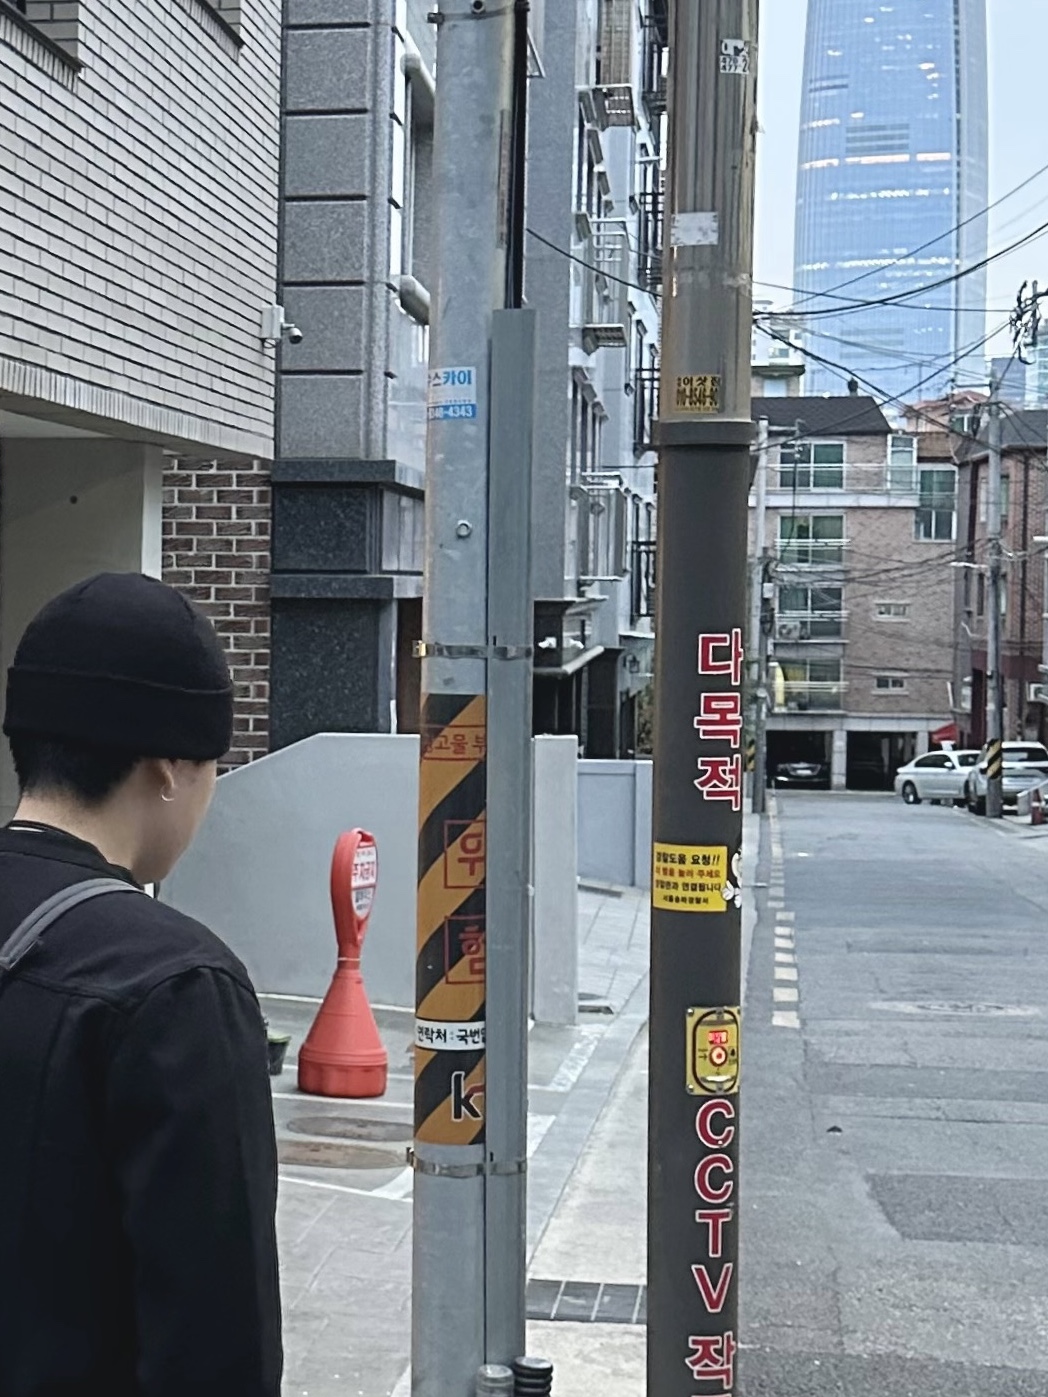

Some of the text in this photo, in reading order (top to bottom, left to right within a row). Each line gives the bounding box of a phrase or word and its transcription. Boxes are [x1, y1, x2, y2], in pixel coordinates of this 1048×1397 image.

[694, 628, 743, 811] 다목적
[417, 1024, 447, 1043] 연락처
[691, 1099, 735, 1313] CCTV
